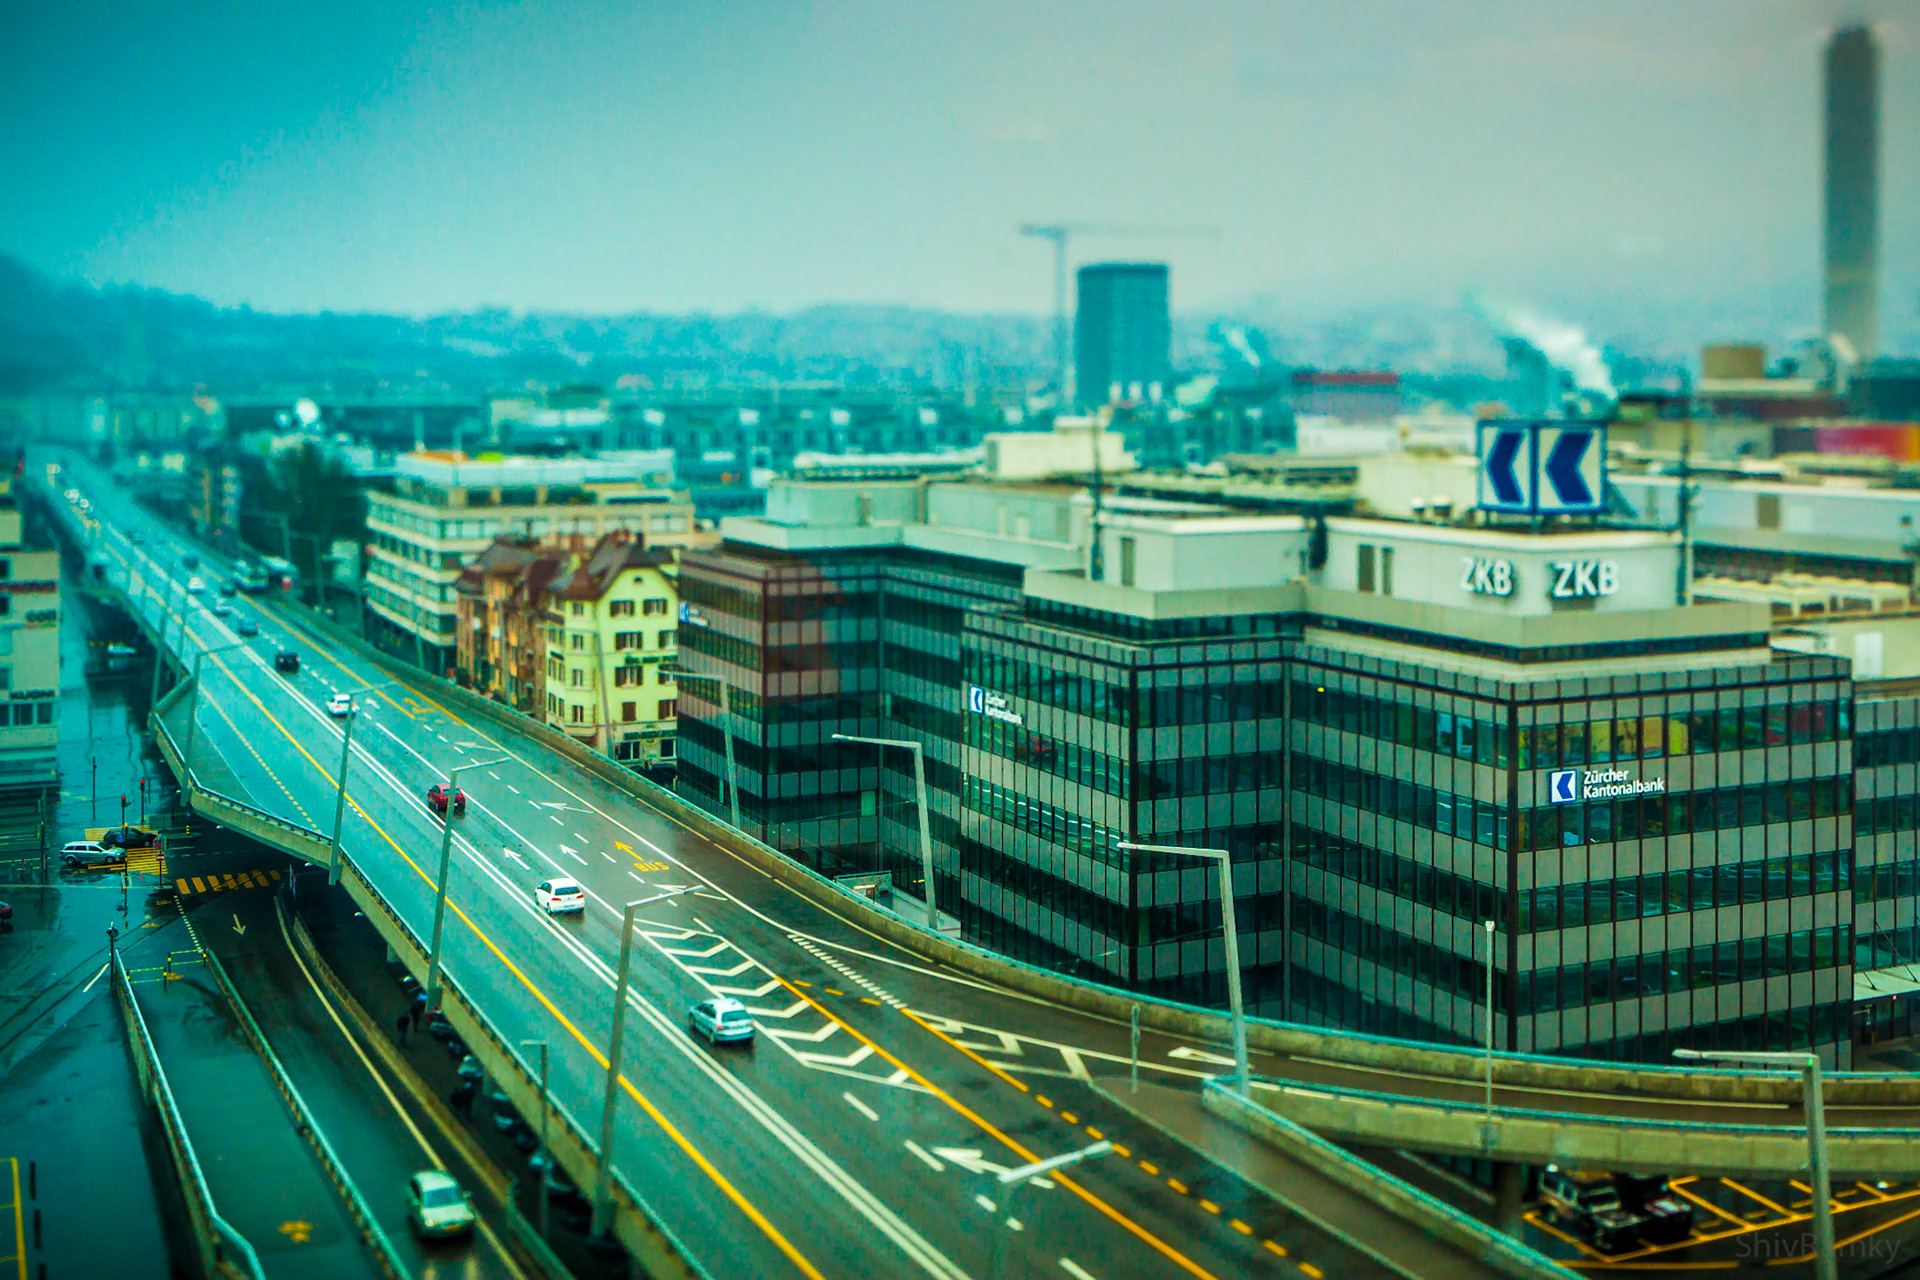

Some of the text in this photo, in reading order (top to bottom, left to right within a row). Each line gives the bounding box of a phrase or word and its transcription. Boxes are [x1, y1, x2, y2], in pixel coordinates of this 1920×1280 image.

[1460, 556, 1512, 596] ZKB
[1553, 560, 1619, 597] ZKB
[1583, 768, 1630, 785] Zürcher
[1583, 777, 1665, 799] Kantonalbank
[632, 861, 670, 872] BUS
